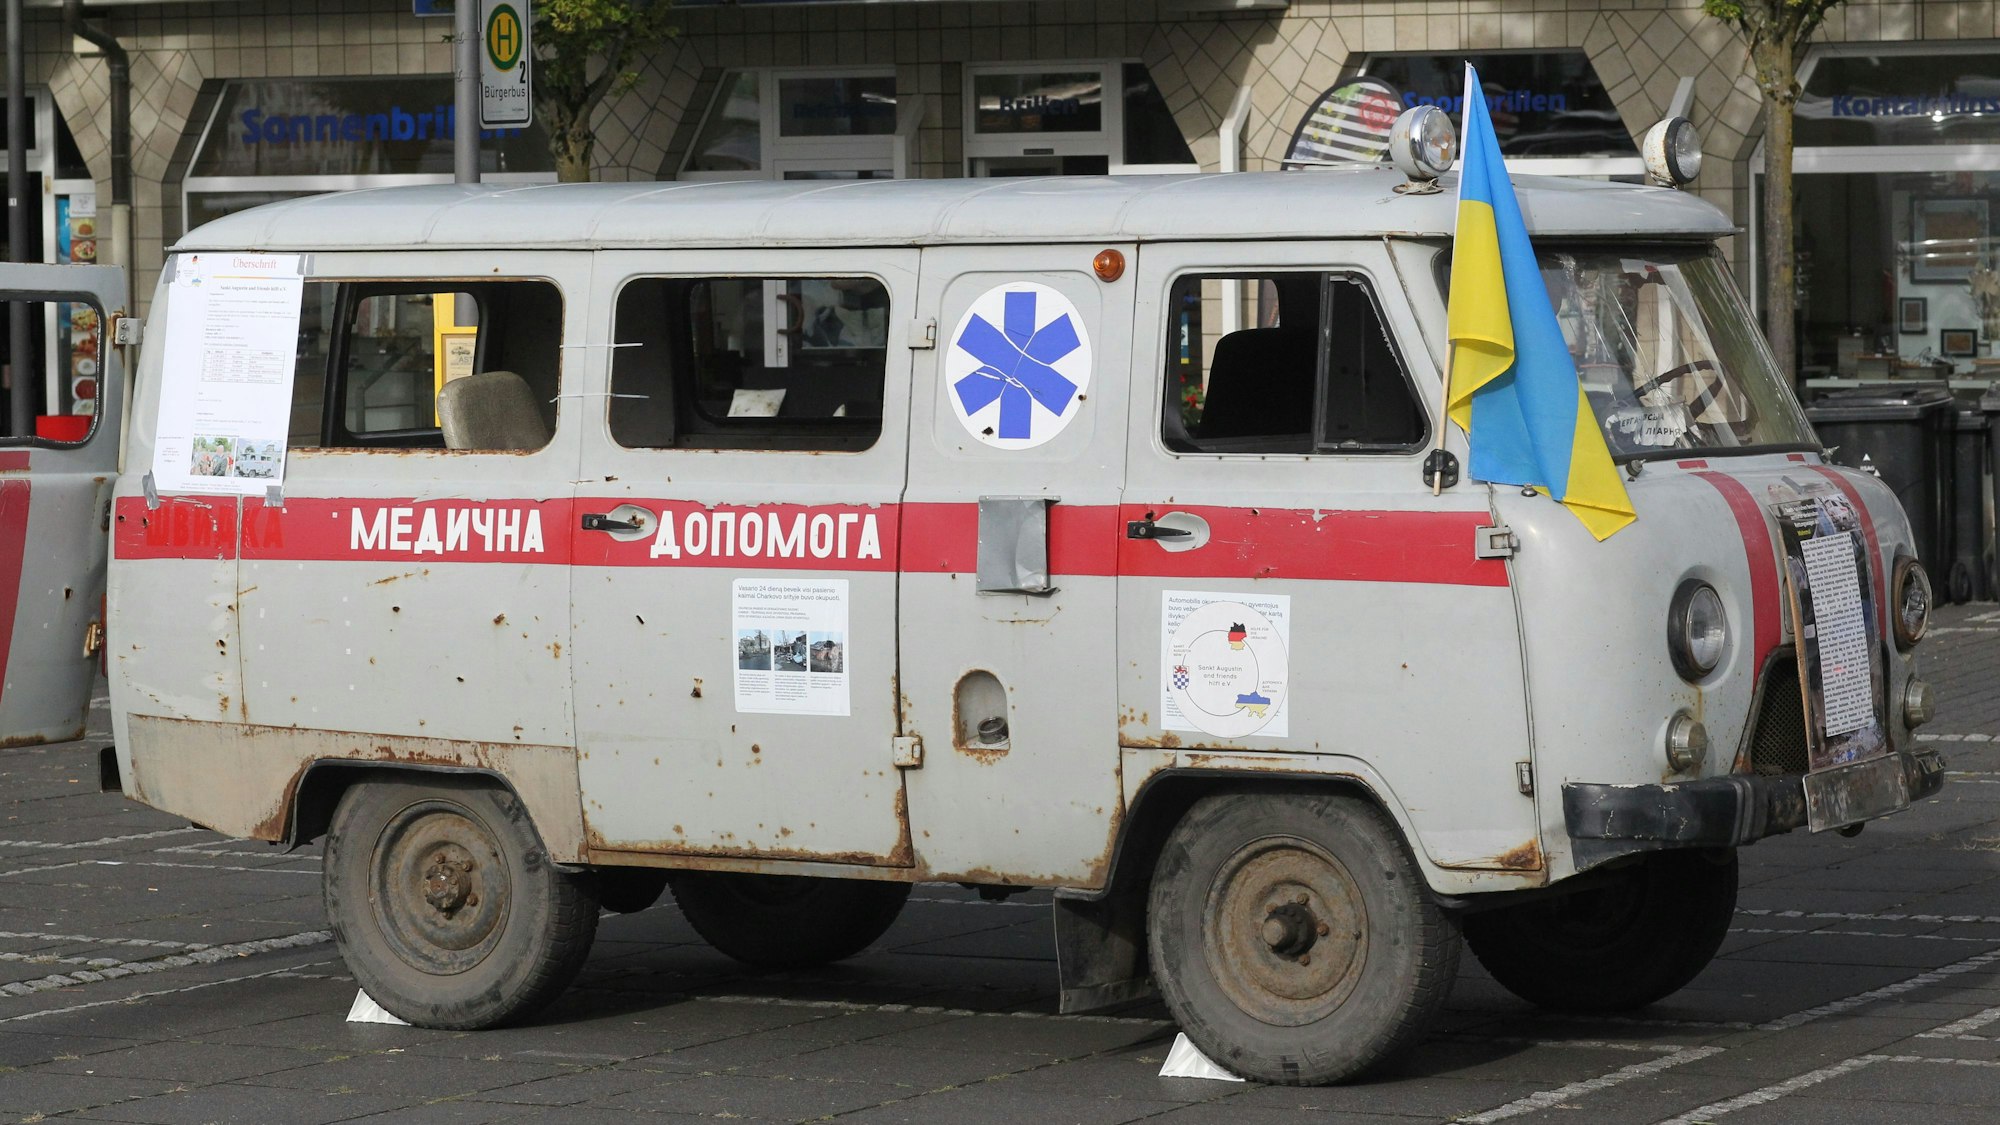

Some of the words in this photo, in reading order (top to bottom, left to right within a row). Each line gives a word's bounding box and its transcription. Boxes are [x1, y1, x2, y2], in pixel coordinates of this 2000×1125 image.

[497, 18, 512, 55] H
[519, 61, 526, 83] 2
[484, 85, 526, 101] Bürgerbus
[241, 105, 521, 144] Sonnenbril
[232, 256, 277, 269] Überschrift
[350, 507, 545, 555] МЕДИЧНА
[649, 510, 882, 560] ДОПОМОГА
[812, 587, 836, 595] pasienio
[1216, 665, 1242, 673] Augustin
